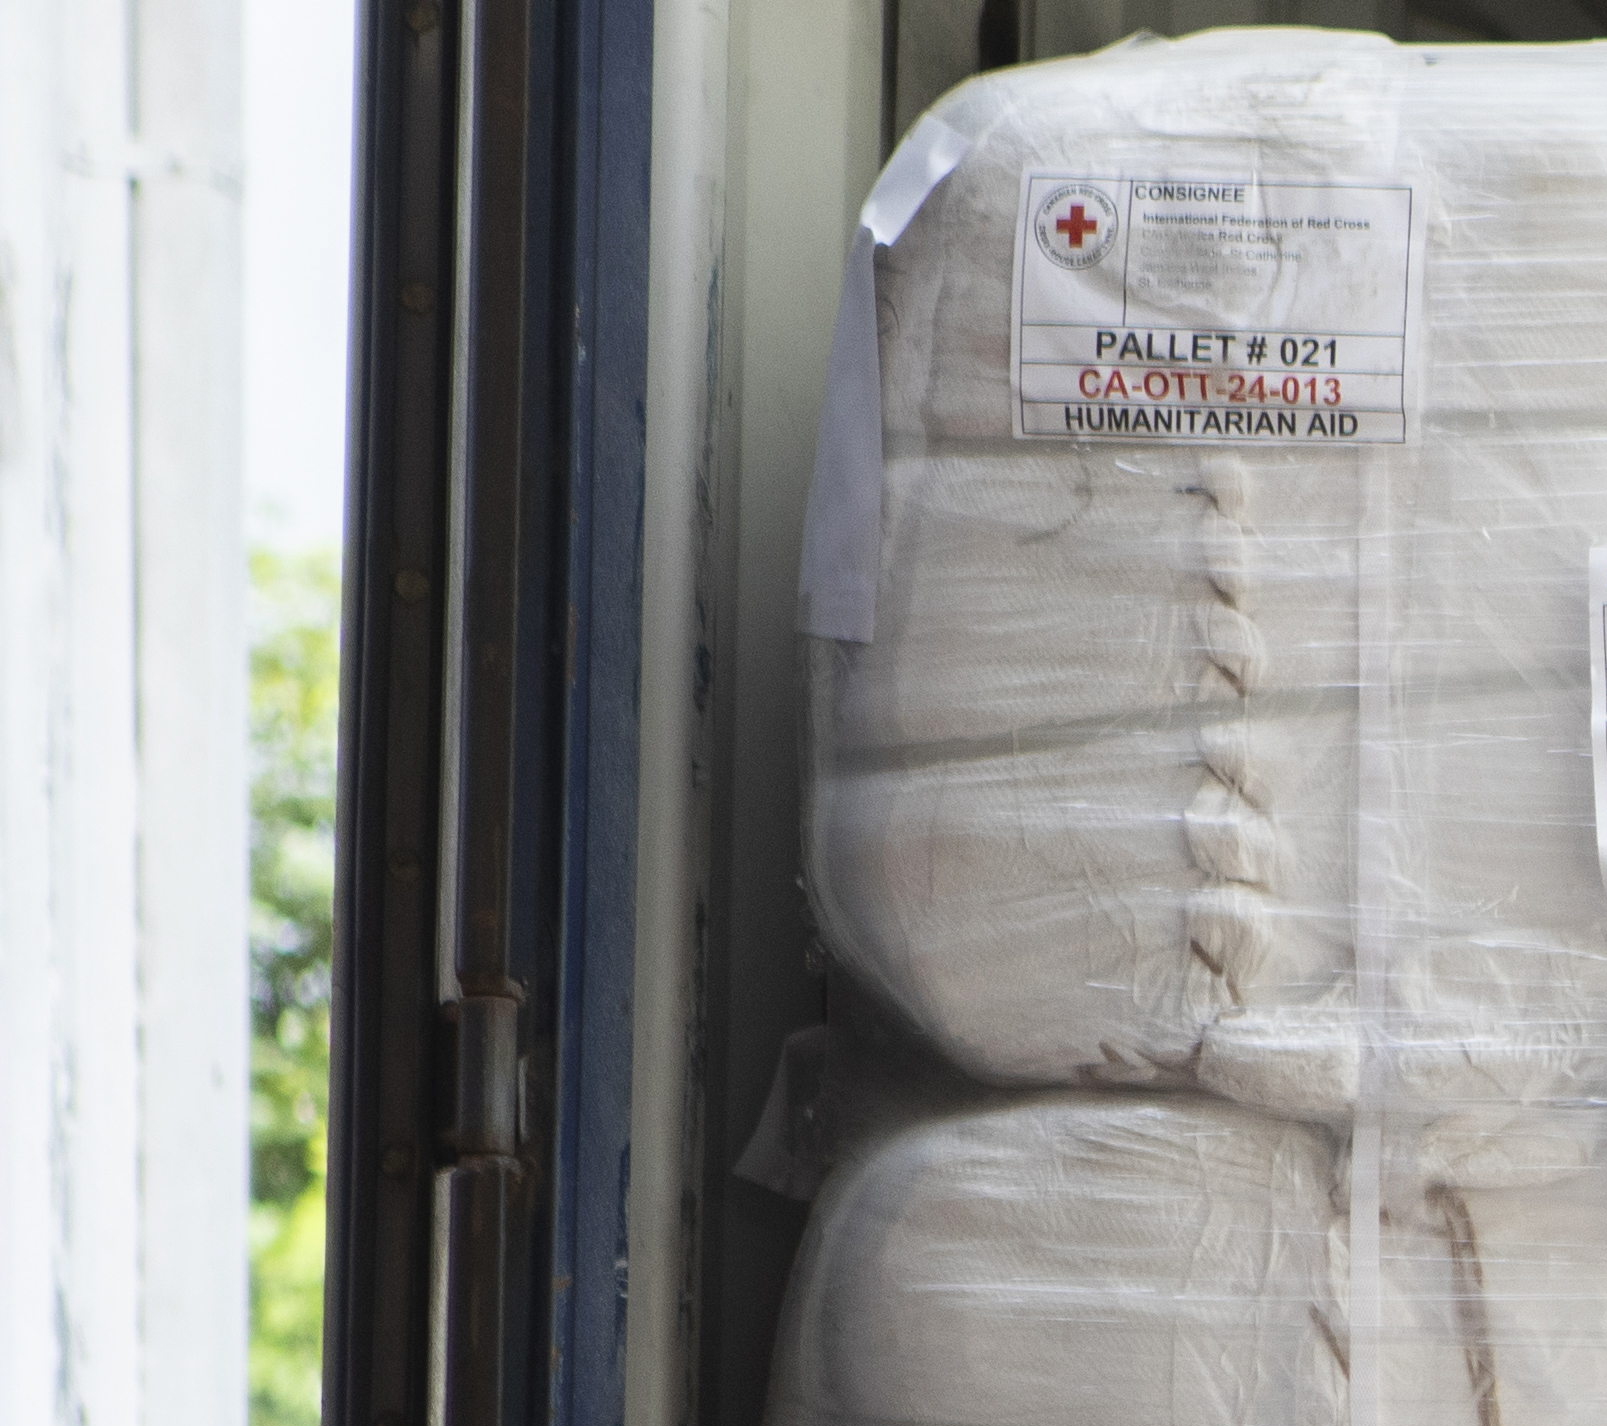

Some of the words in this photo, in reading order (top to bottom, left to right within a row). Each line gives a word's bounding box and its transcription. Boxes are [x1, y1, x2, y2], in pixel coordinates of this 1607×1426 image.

[1135, 185, 1245, 203] CONSIGNEE
[1142, 212, 1218, 226] International
[1221, 214, 1288, 228] Federation
[1291, 217, 1305, 229] of
[1307, 218, 1331, 230] Red
[1334, 219, 1371, 231] Cross
[1218, 231, 1243, 244] Red
[1096, 331, 1235, 365] PALLET
[1247, 336, 1268, 364] #
[1280, 338, 1338, 369] 021
[1079, 368, 1342, 407] CA-OTT-24-013
[1064, 406, 1297, 437] HUMANITARIAN
[1307, 410, 1358, 438] AID
